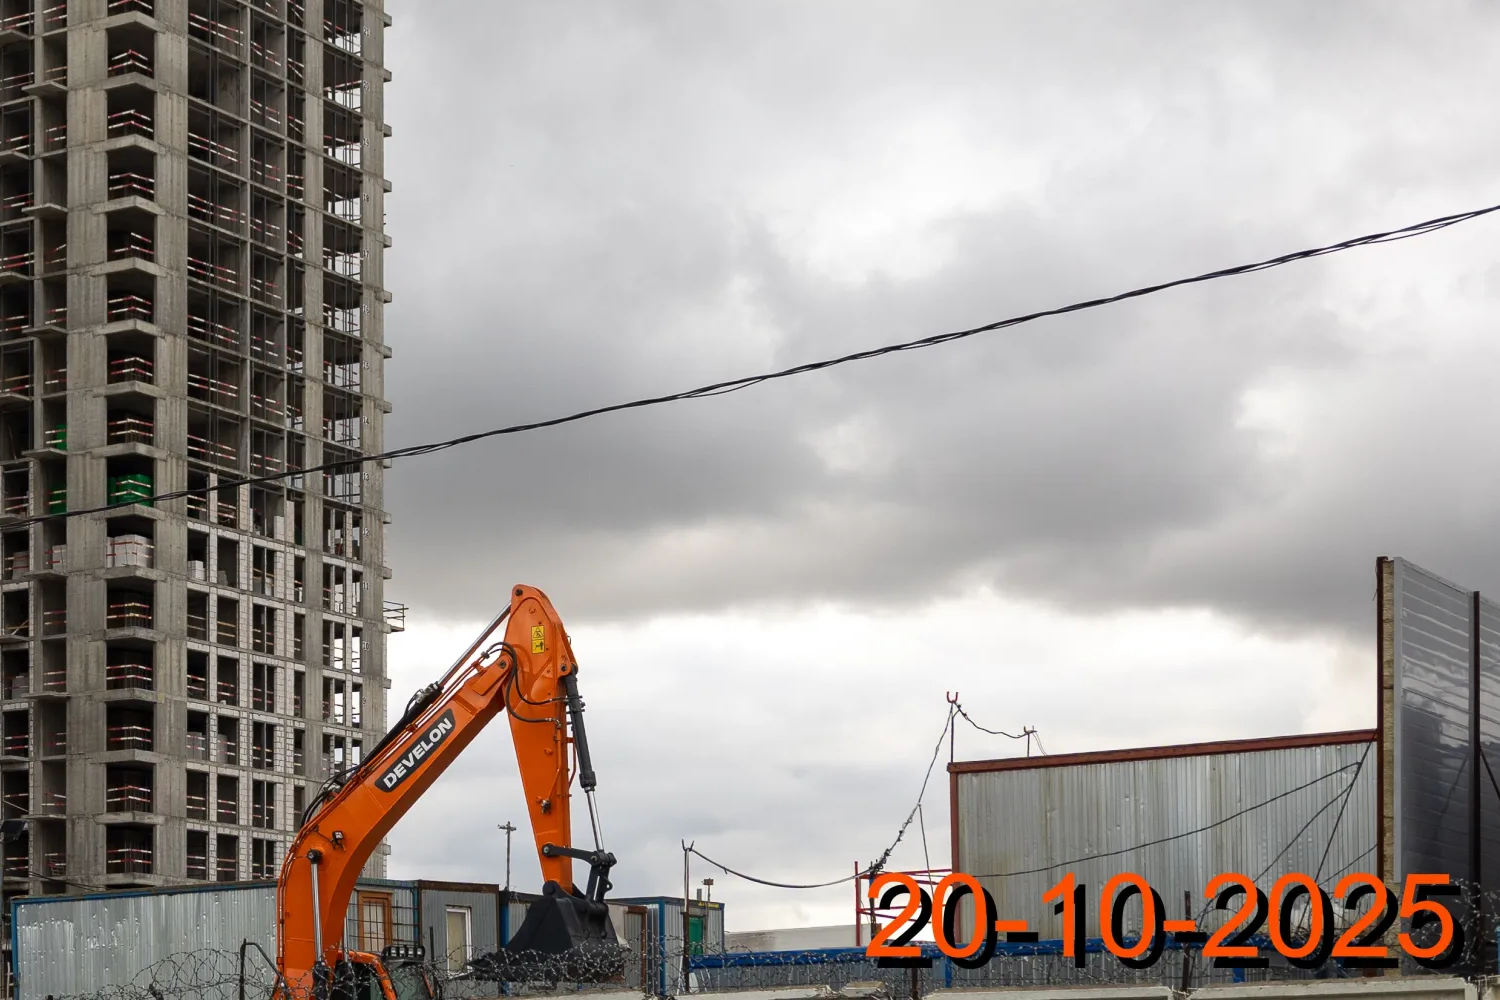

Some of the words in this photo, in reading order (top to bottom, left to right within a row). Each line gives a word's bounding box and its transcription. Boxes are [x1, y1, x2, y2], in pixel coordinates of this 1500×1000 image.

[363, 472, 370, 482] 13
[363, 527, 370, 537] 12
[363, 581, 370, 591] 11
[363, 641, 370, 651] 10
[383, 717, 453, 788] DEVELON
